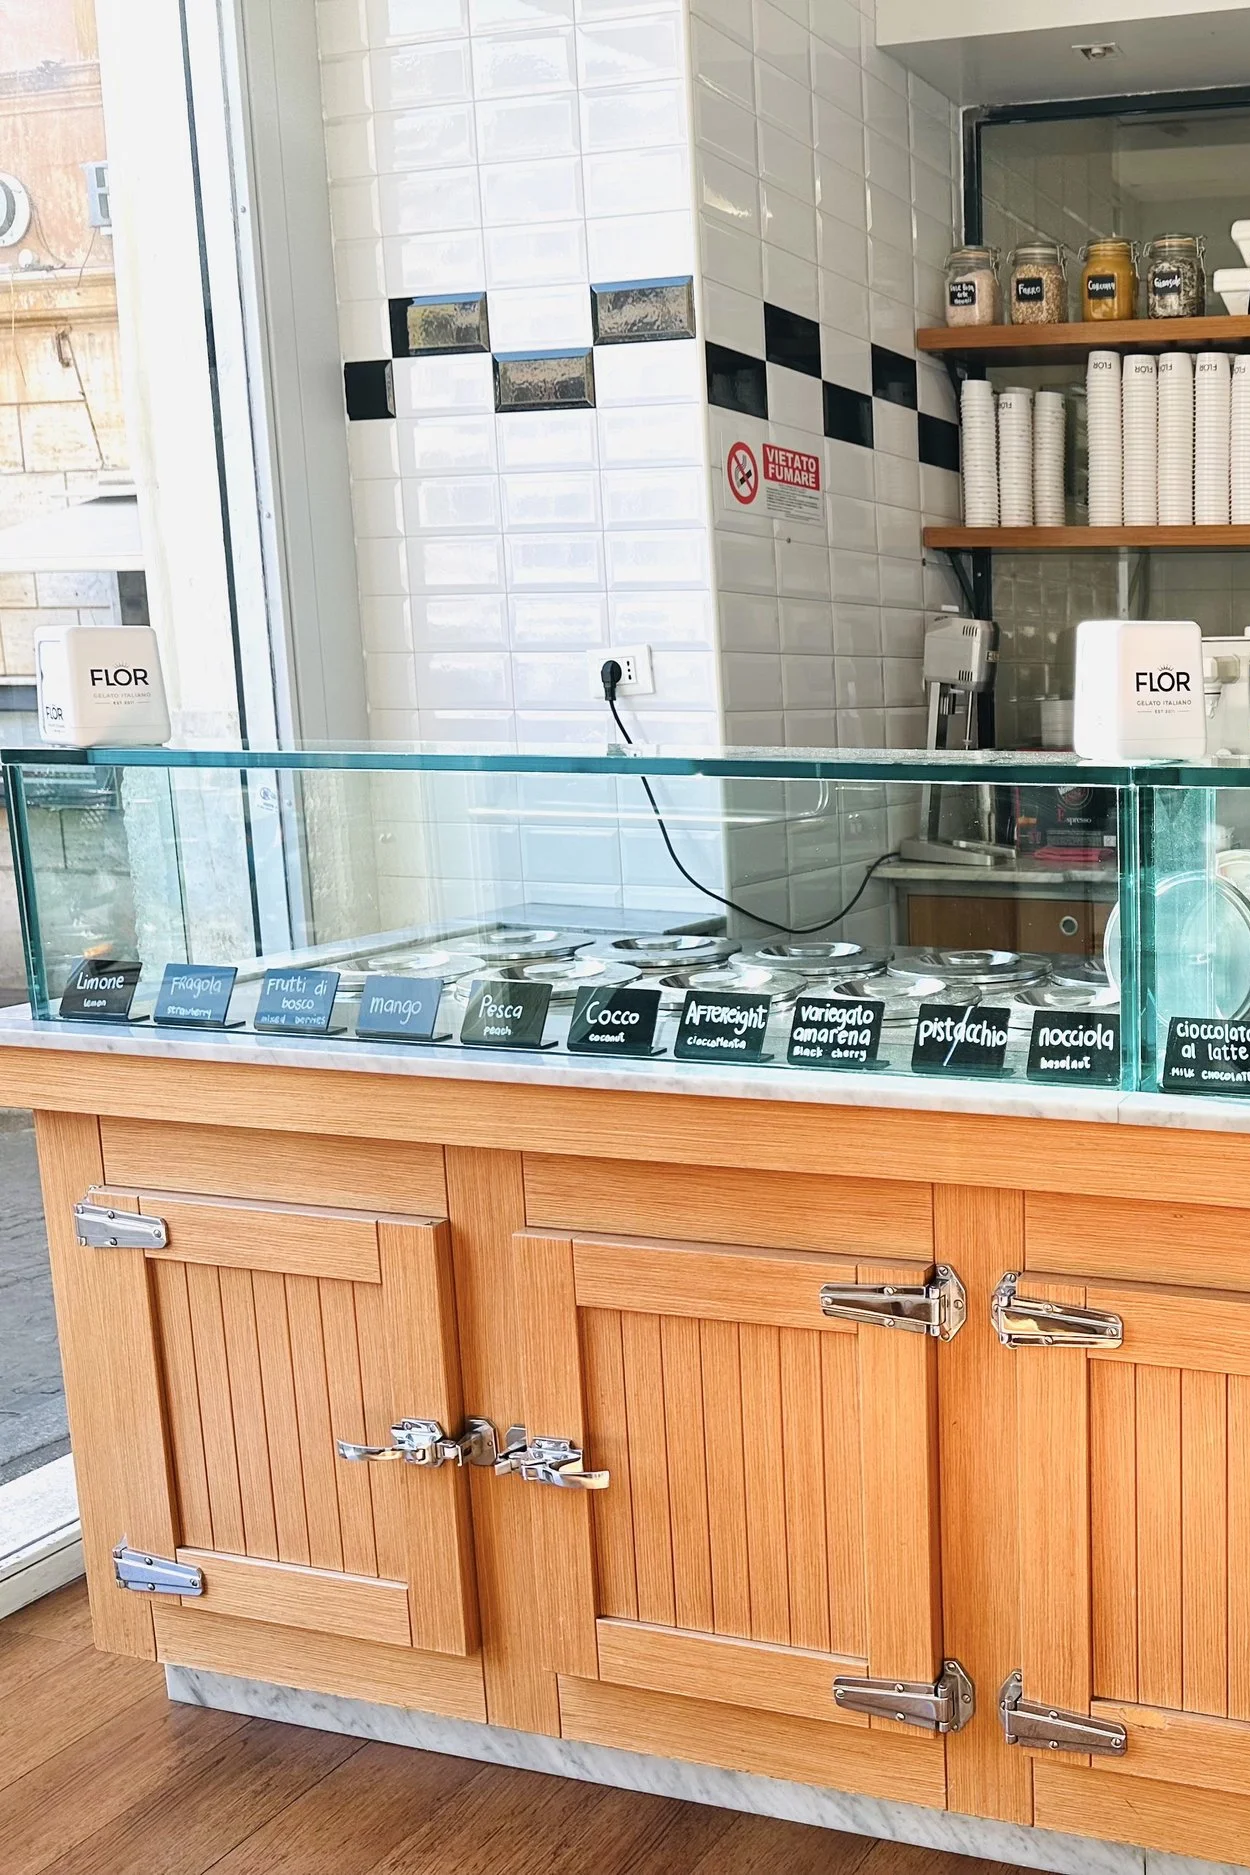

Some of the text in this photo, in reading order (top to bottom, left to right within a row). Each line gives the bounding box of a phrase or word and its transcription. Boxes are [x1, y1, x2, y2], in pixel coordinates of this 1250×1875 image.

[766, 447, 816, 473] VIETATO
[768, 464, 816, 488] FUMARE
[90, 668, 150, 686] FLOR
[1136, 671, 1191, 692] FLOR
[76, 972, 125, 990] Limone
[267, 976, 328, 996] Frutti di
[83, 998, 107, 1007] lemon
[167, 1005, 211, 1018] strawberry
[281, 997, 315, 1010] bosco
[479, 994, 523, 1020] Pesca
[261, 1015, 326, 1025] mixed berries
[586, 1001, 640, 1026] Cocco
[484, 1026, 511, 1036] peach
[589, 1032, 625, 1043] coconut
[793, 1026, 871, 1046] amarena
[919, 1017, 1007, 1047] pistacchio
[1038, 1024, 1114, 1050] nocciola
[831, 1048, 867, 1062] cherry
[1181, 1044, 1249, 1061] al latte
[1171, 1067, 1195, 1078] MILK
